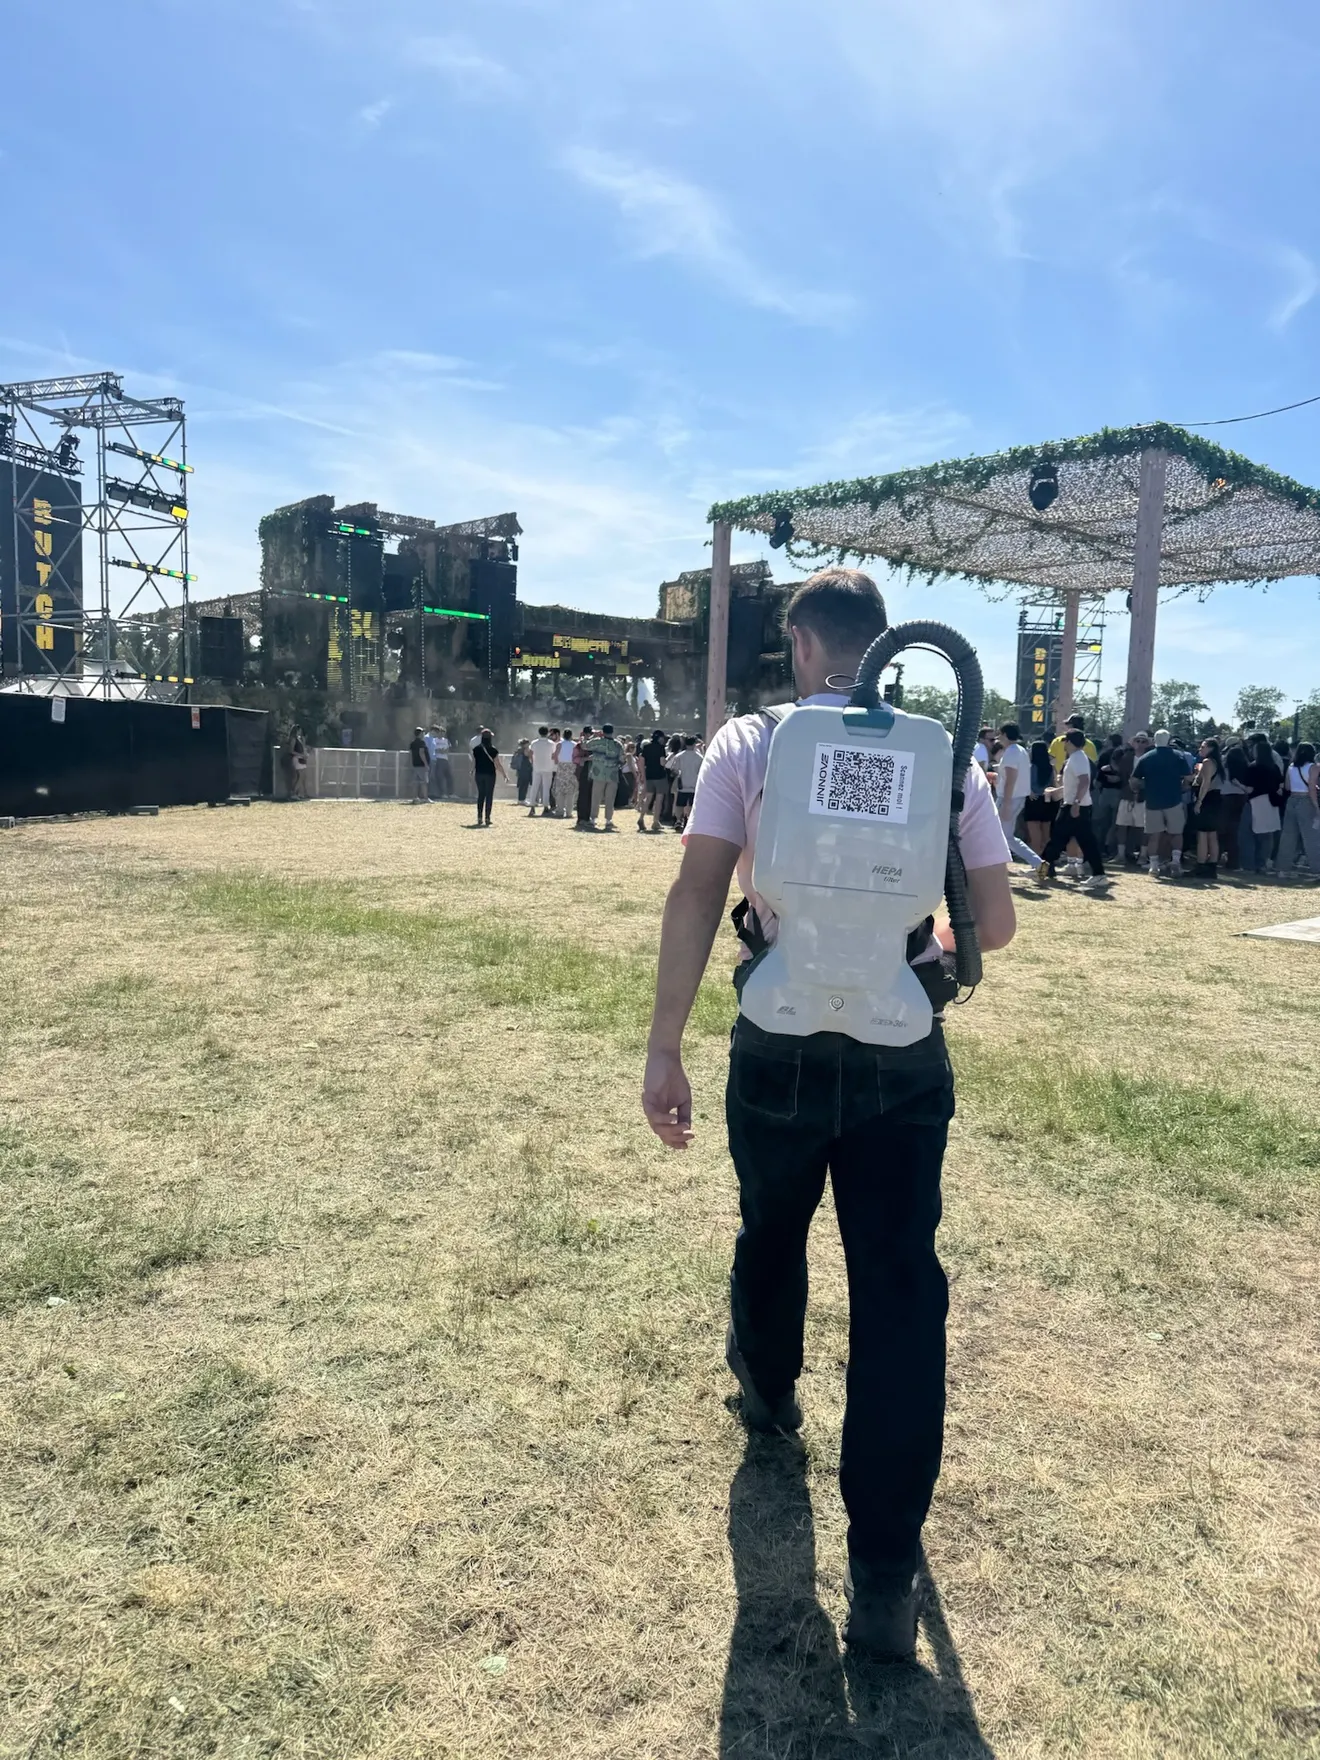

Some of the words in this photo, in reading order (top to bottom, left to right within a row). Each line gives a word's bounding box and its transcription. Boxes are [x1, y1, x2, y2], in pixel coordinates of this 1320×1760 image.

[816, 753, 829, 806] JINNOVE
[898, 765, 908, 791] Scannez
[871, 865, 902, 877] HEPA
